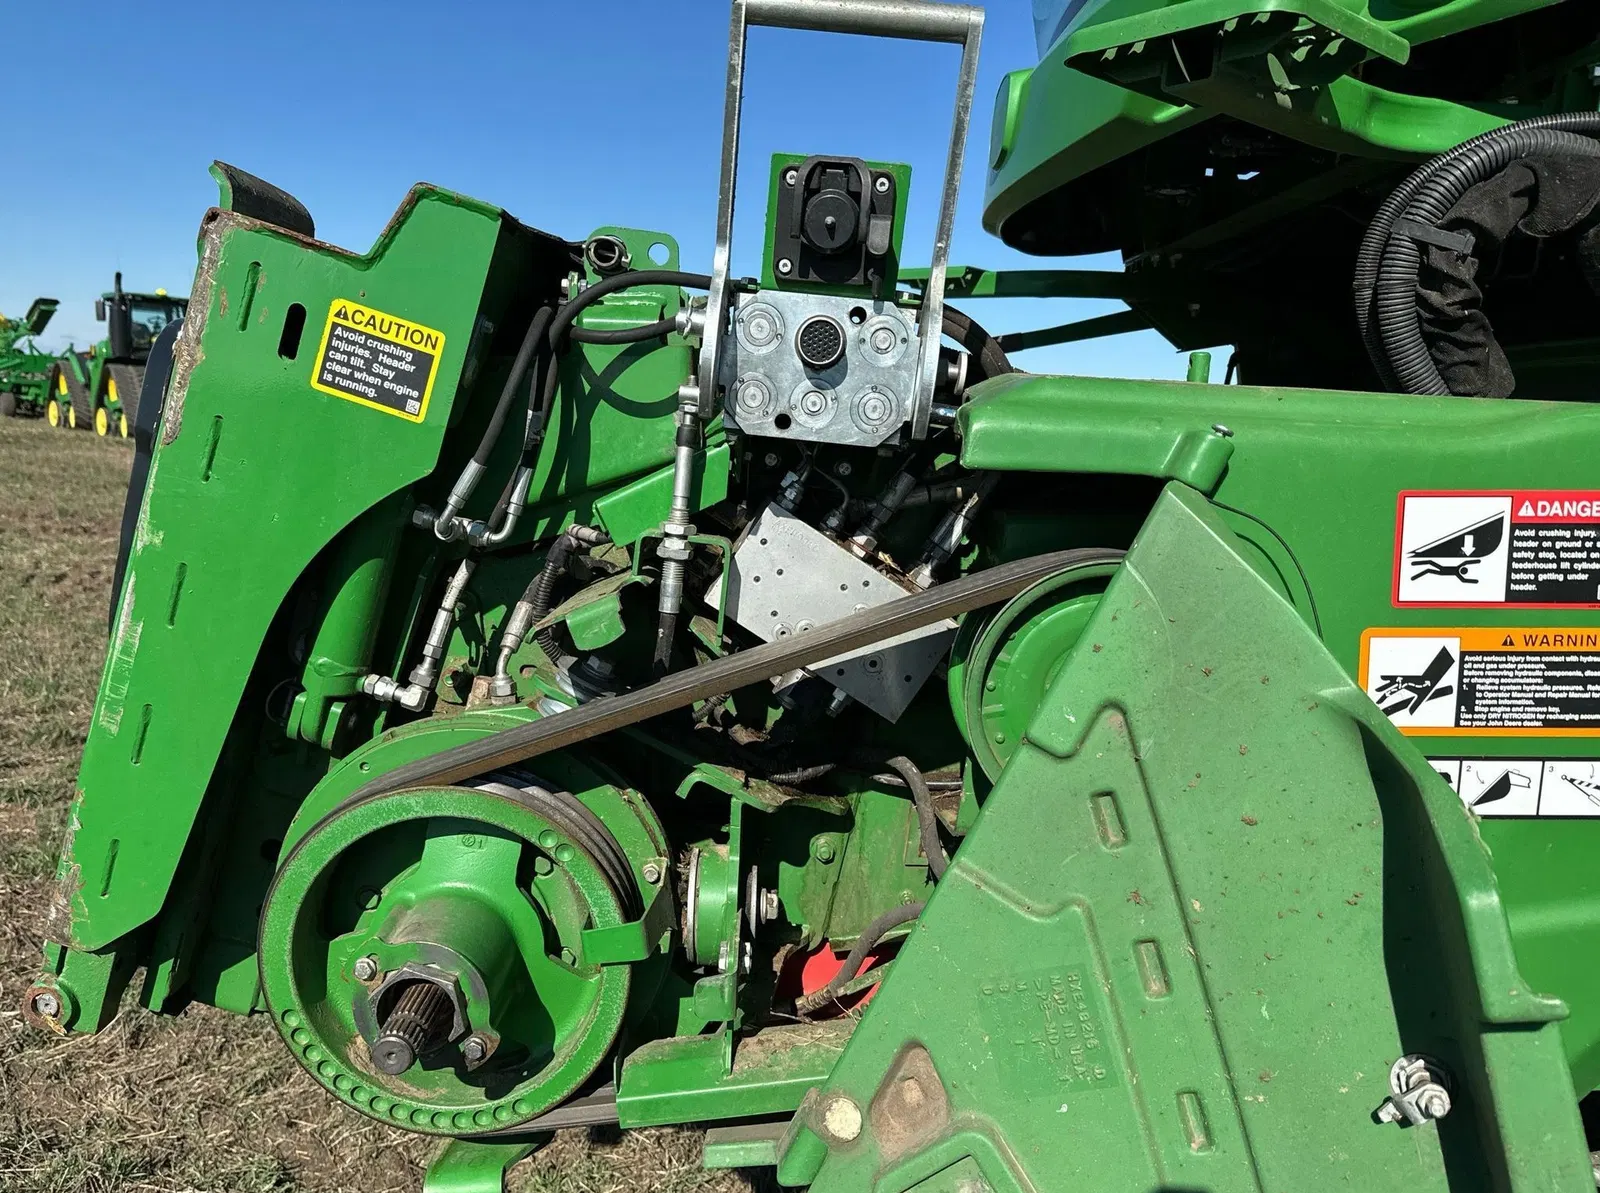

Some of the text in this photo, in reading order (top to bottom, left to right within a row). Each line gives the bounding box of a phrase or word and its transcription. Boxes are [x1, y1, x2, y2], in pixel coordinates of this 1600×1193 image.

[351, 309, 439, 351] CAUTION
[334, 326, 413, 362] Avoid crushing
[331, 337, 416, 373] injuries. Header
[329, 351, 395, 380] can tilt. Stay
[323, 371, 378, 398] is running.
[326, 360, 419, 398] clear when engine
[1536, 500, 1600, 517] DANGE
[1514, 528, 1597, 539] Avoid crushing injury.
[1513, 540, 1539, 548] header
[1555, 540, 1582, 550] ground
[1512, 551, 1536, 560] safety
[1538, 551, 1557, 560] stop,
[1560, 550, 1587, 559] located
[1511, 561, 1557, 569] feederhouse
[1560, 561, 1571, 569] lift
[1511, 572, 1589, 582] before getting under
[1510, 583, 1537, 591] header.
[1523, 634, 1598, 647] WARNIN
[1548, 766, 1554, 774] 3
[1050, 975, 1068, 1015] MADE
[1062, 1022, 1077, 1039] IN
